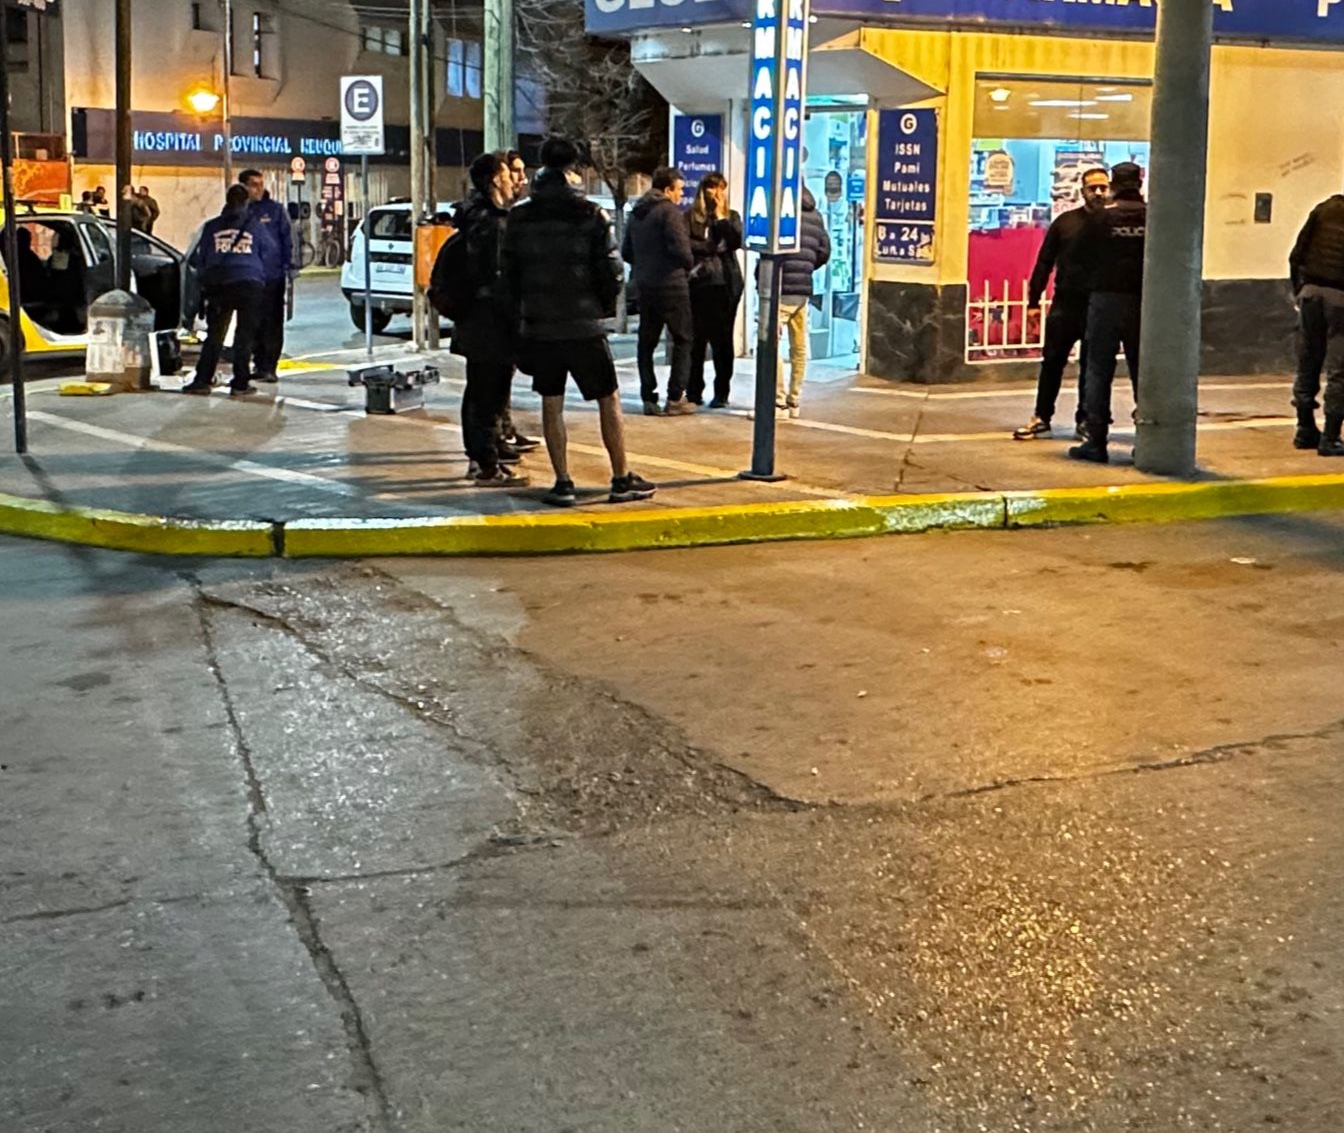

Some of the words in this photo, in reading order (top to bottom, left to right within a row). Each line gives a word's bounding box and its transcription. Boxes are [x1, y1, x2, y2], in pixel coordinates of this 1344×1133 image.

[353, 88, 371, 113] E
[133, 131, 201, 152] HOSPITAL
[214, 134, 292, 154] POVINCIAL
[300, 137, 342, 155] NEUQU
[685, 144, 709, 154] Salud
[895, 143, 920, 155] ISSN
[678, 161, 716, 171] Perfumes
[894, 162, 920, 174] Pami
[882, 180, 930, 193] Mutuales
[884, 198, 927, 213] Tarjetas
[901, 227, 918, 241] 24
[1112, 226, 1145, 237] POLIC
